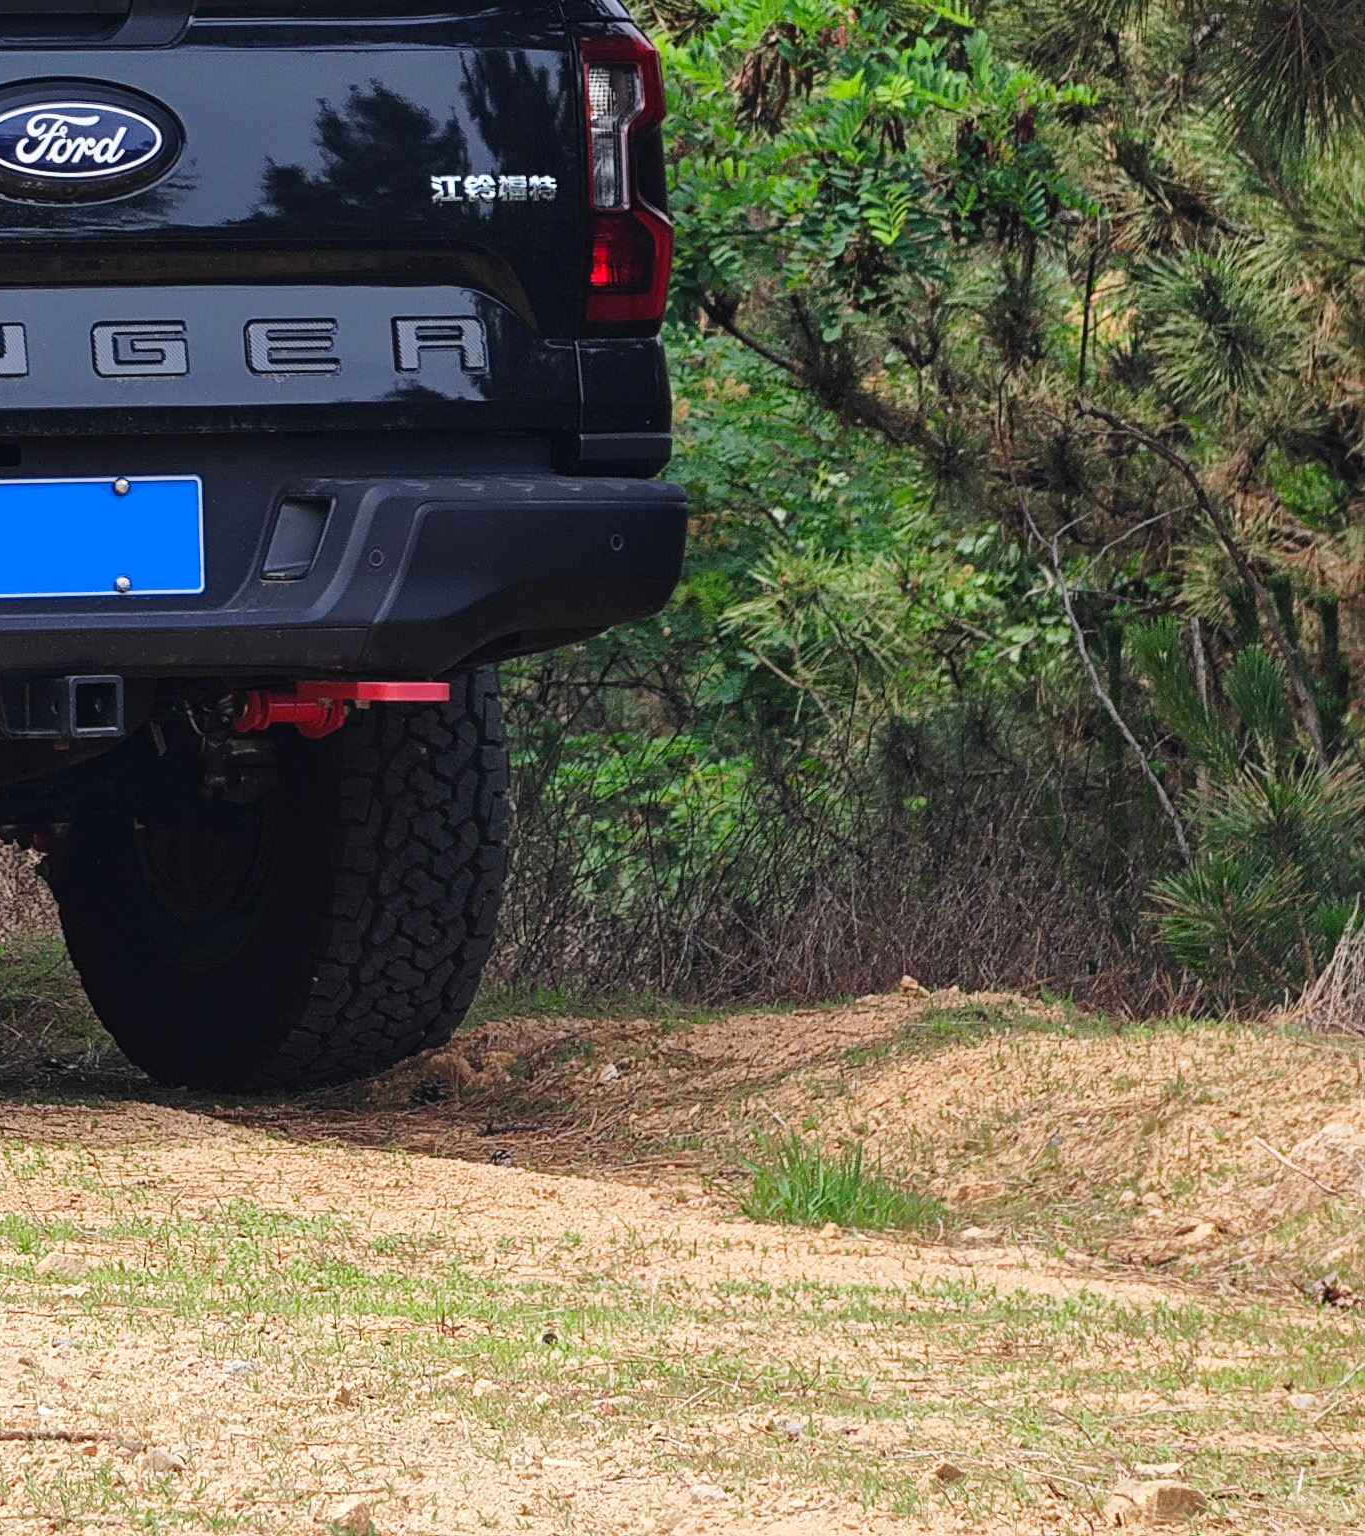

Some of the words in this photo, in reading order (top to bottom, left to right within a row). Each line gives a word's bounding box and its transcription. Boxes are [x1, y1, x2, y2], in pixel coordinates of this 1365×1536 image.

[15, 114, 128, 164] Ford
[431, 175, 558, 203] 江铃福特
